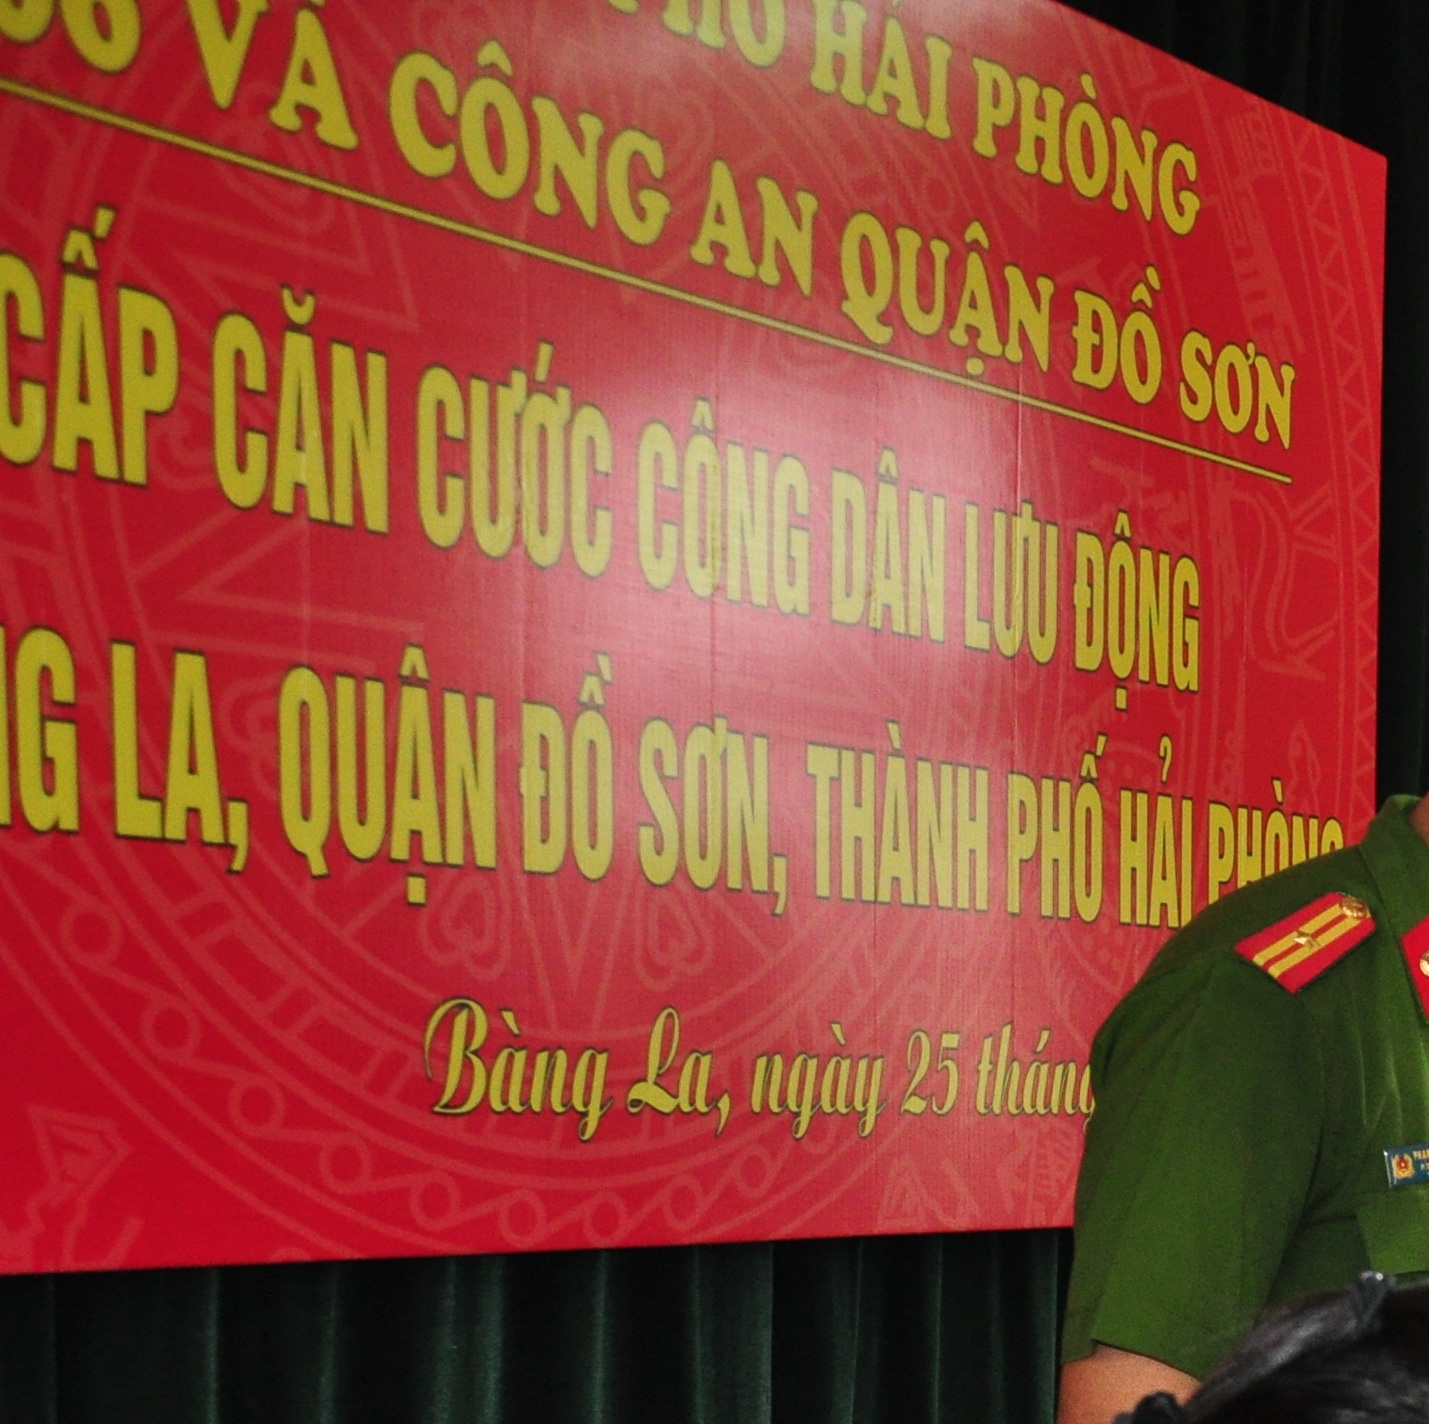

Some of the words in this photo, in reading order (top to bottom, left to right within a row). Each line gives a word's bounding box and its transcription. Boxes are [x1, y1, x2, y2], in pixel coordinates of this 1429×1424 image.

[389, 40, 672, 247] CÔNG
[690, 158, 819, 297] AN
[840, 219, 1056, 377] QUẬN
[1071, 264, 1162, 405] ĐỒ
[1179, 329, 1296, 450] SƠN
[971, 72, 1201, 236] PHÒNG
[0, 206, 180, 487] CẤP
[212, 285, 390, 534] CĂN
[416, 340, 614, 578] CƯỚC
[637, 397, 811, 616] CÔNG
[830, 447, 947, 645] DÂN
[963, 500, 1059, 665] LƯU
[1072, 508, 1200, 711] ĐỘNG
[110, 637, 250, 875] LA,
[277, 642, 498, 906] QUẬN
[519, 651, 614, 882] ĐỒ
[637, 713, 788, 917] SƠN,
[806, 718, 990, 913] THÀNH
[1006, 732, 1108, 923] PHỐ
[1118, 734, 1195, 929] HẢI
[423, 995, 614, 1141] Bàng
[626, 1005, 732, 1138] La,
[750, 1019, 887, 1140] ngày
[900, 1027, 961, 1116] 25
